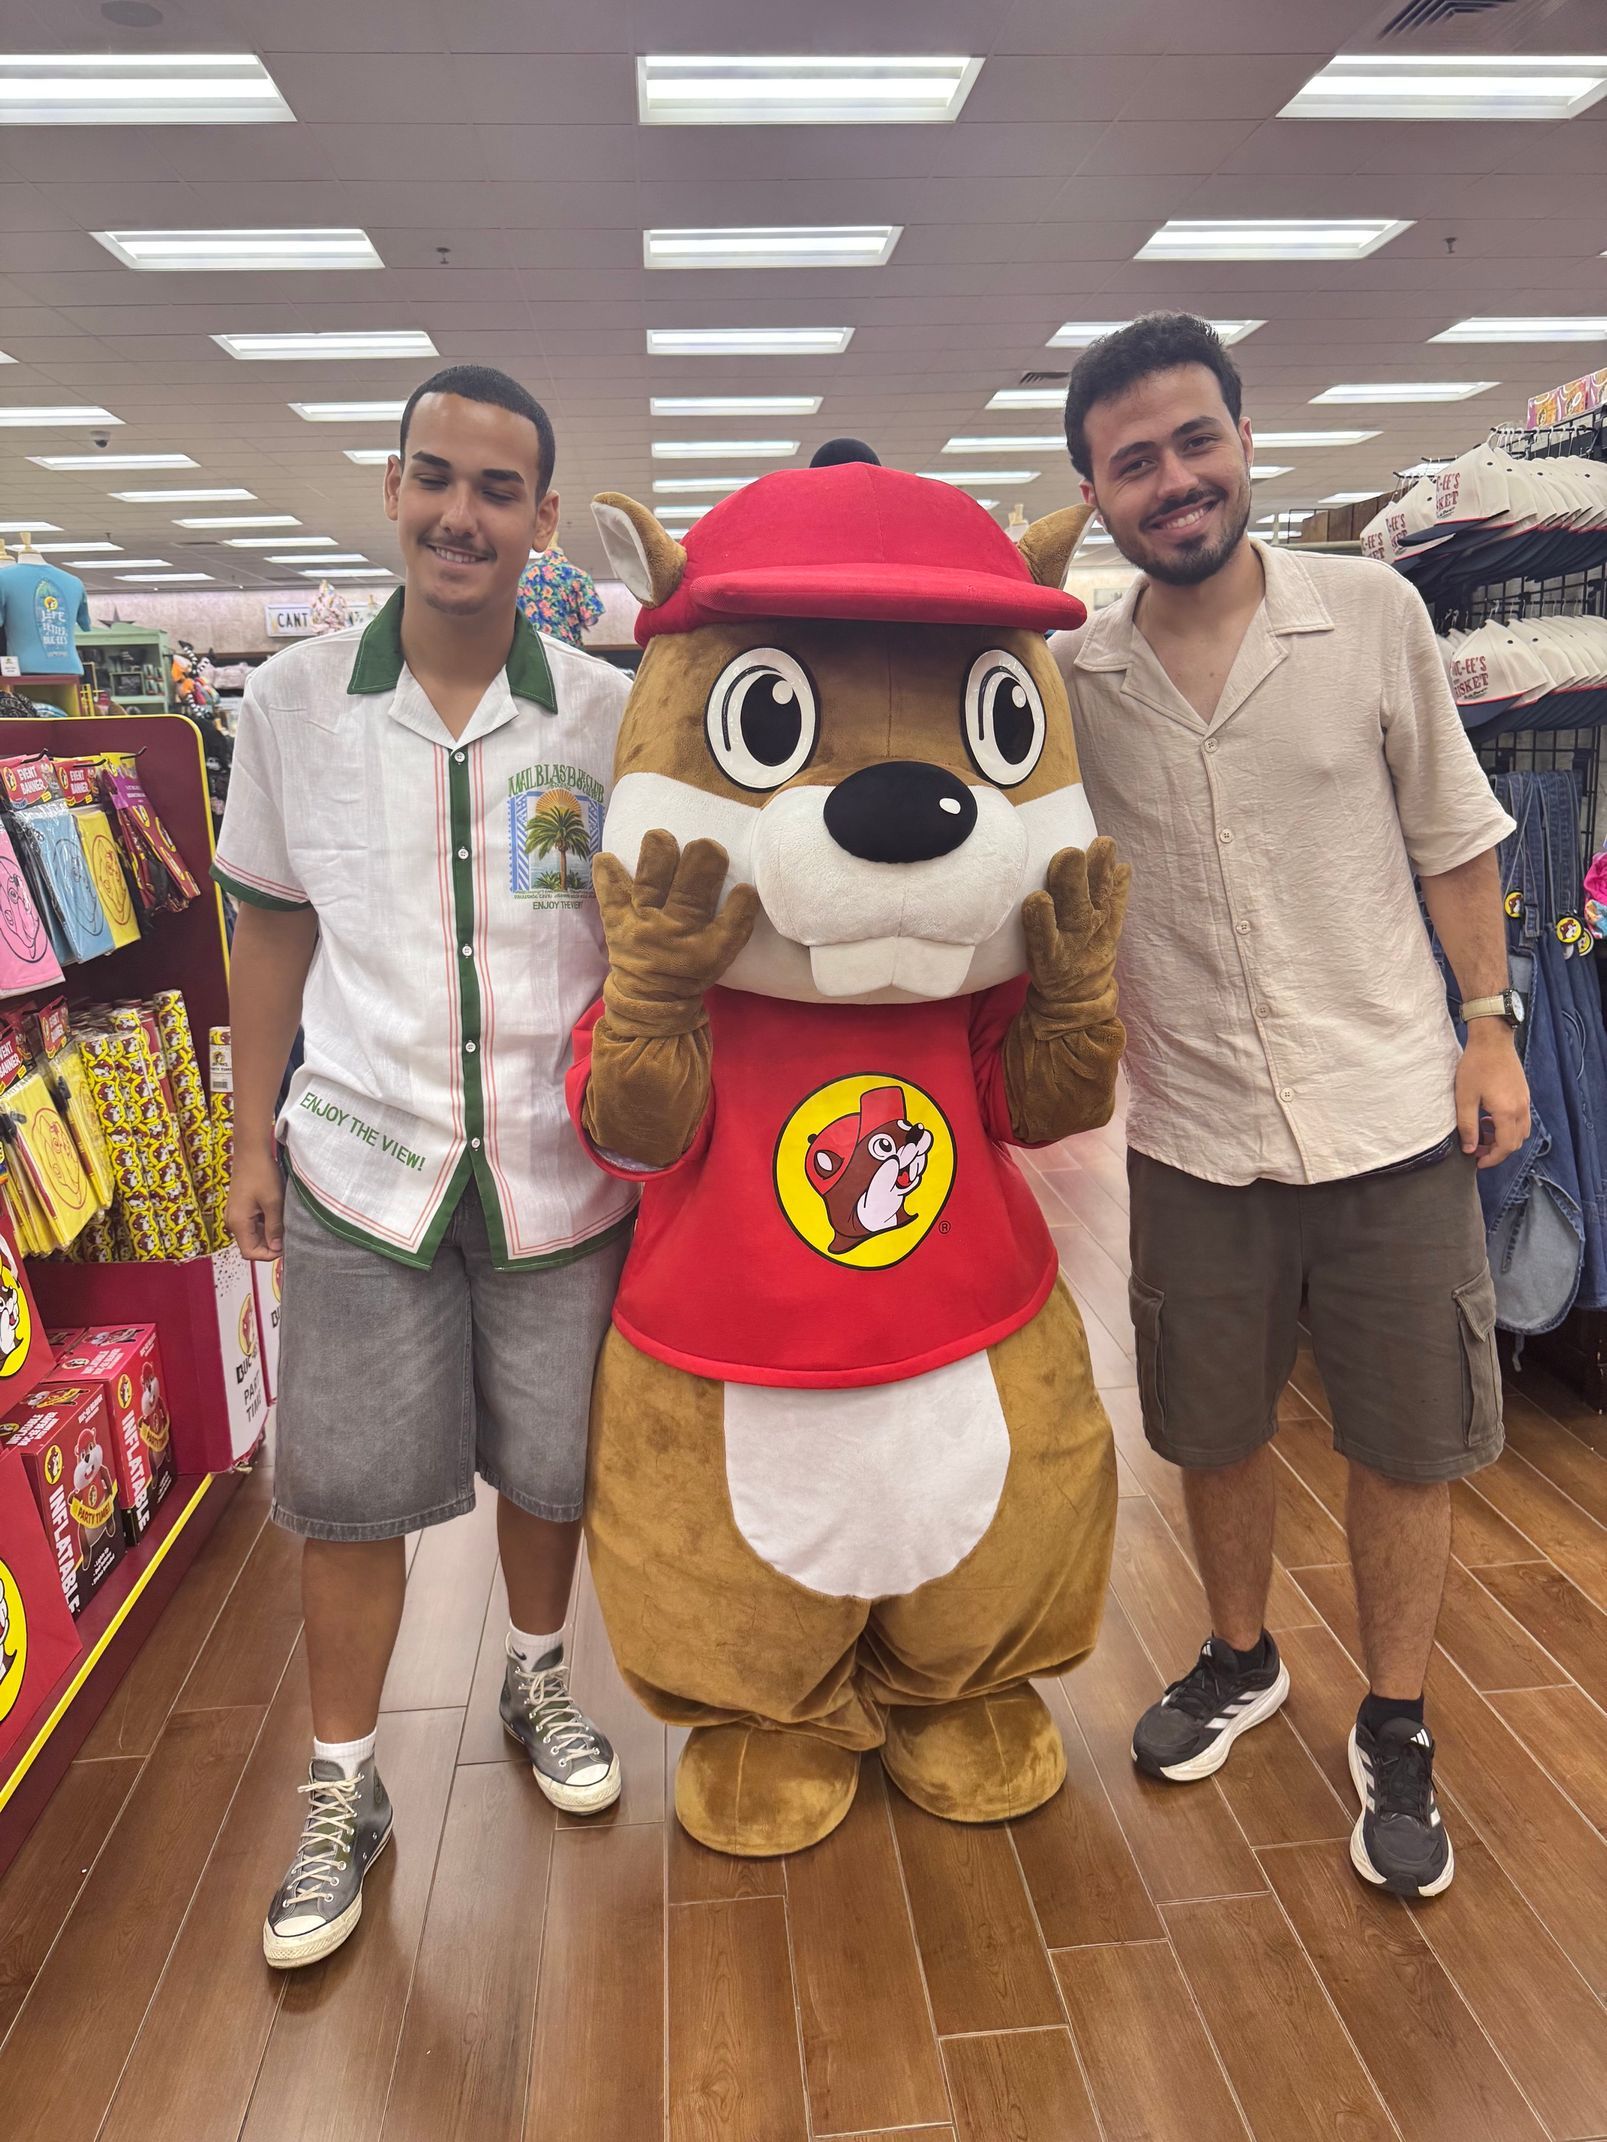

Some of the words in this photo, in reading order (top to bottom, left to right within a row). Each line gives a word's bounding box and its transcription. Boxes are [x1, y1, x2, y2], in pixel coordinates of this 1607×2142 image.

[532, 901, 559, 910] ENJOY
[0, 1040, 13, 1061] VENT
[300, 1092, 350, 1126] ENJOY
[349, 1117, 380, 1146] THE
[382, 1135, 426, 1172] VIEW!
[121, 1409, 150, 1532] INFLATABLE
[78, 1506, 95, 1525] PARTY
[49, 1484, 81, 1613] INFLATABLE
